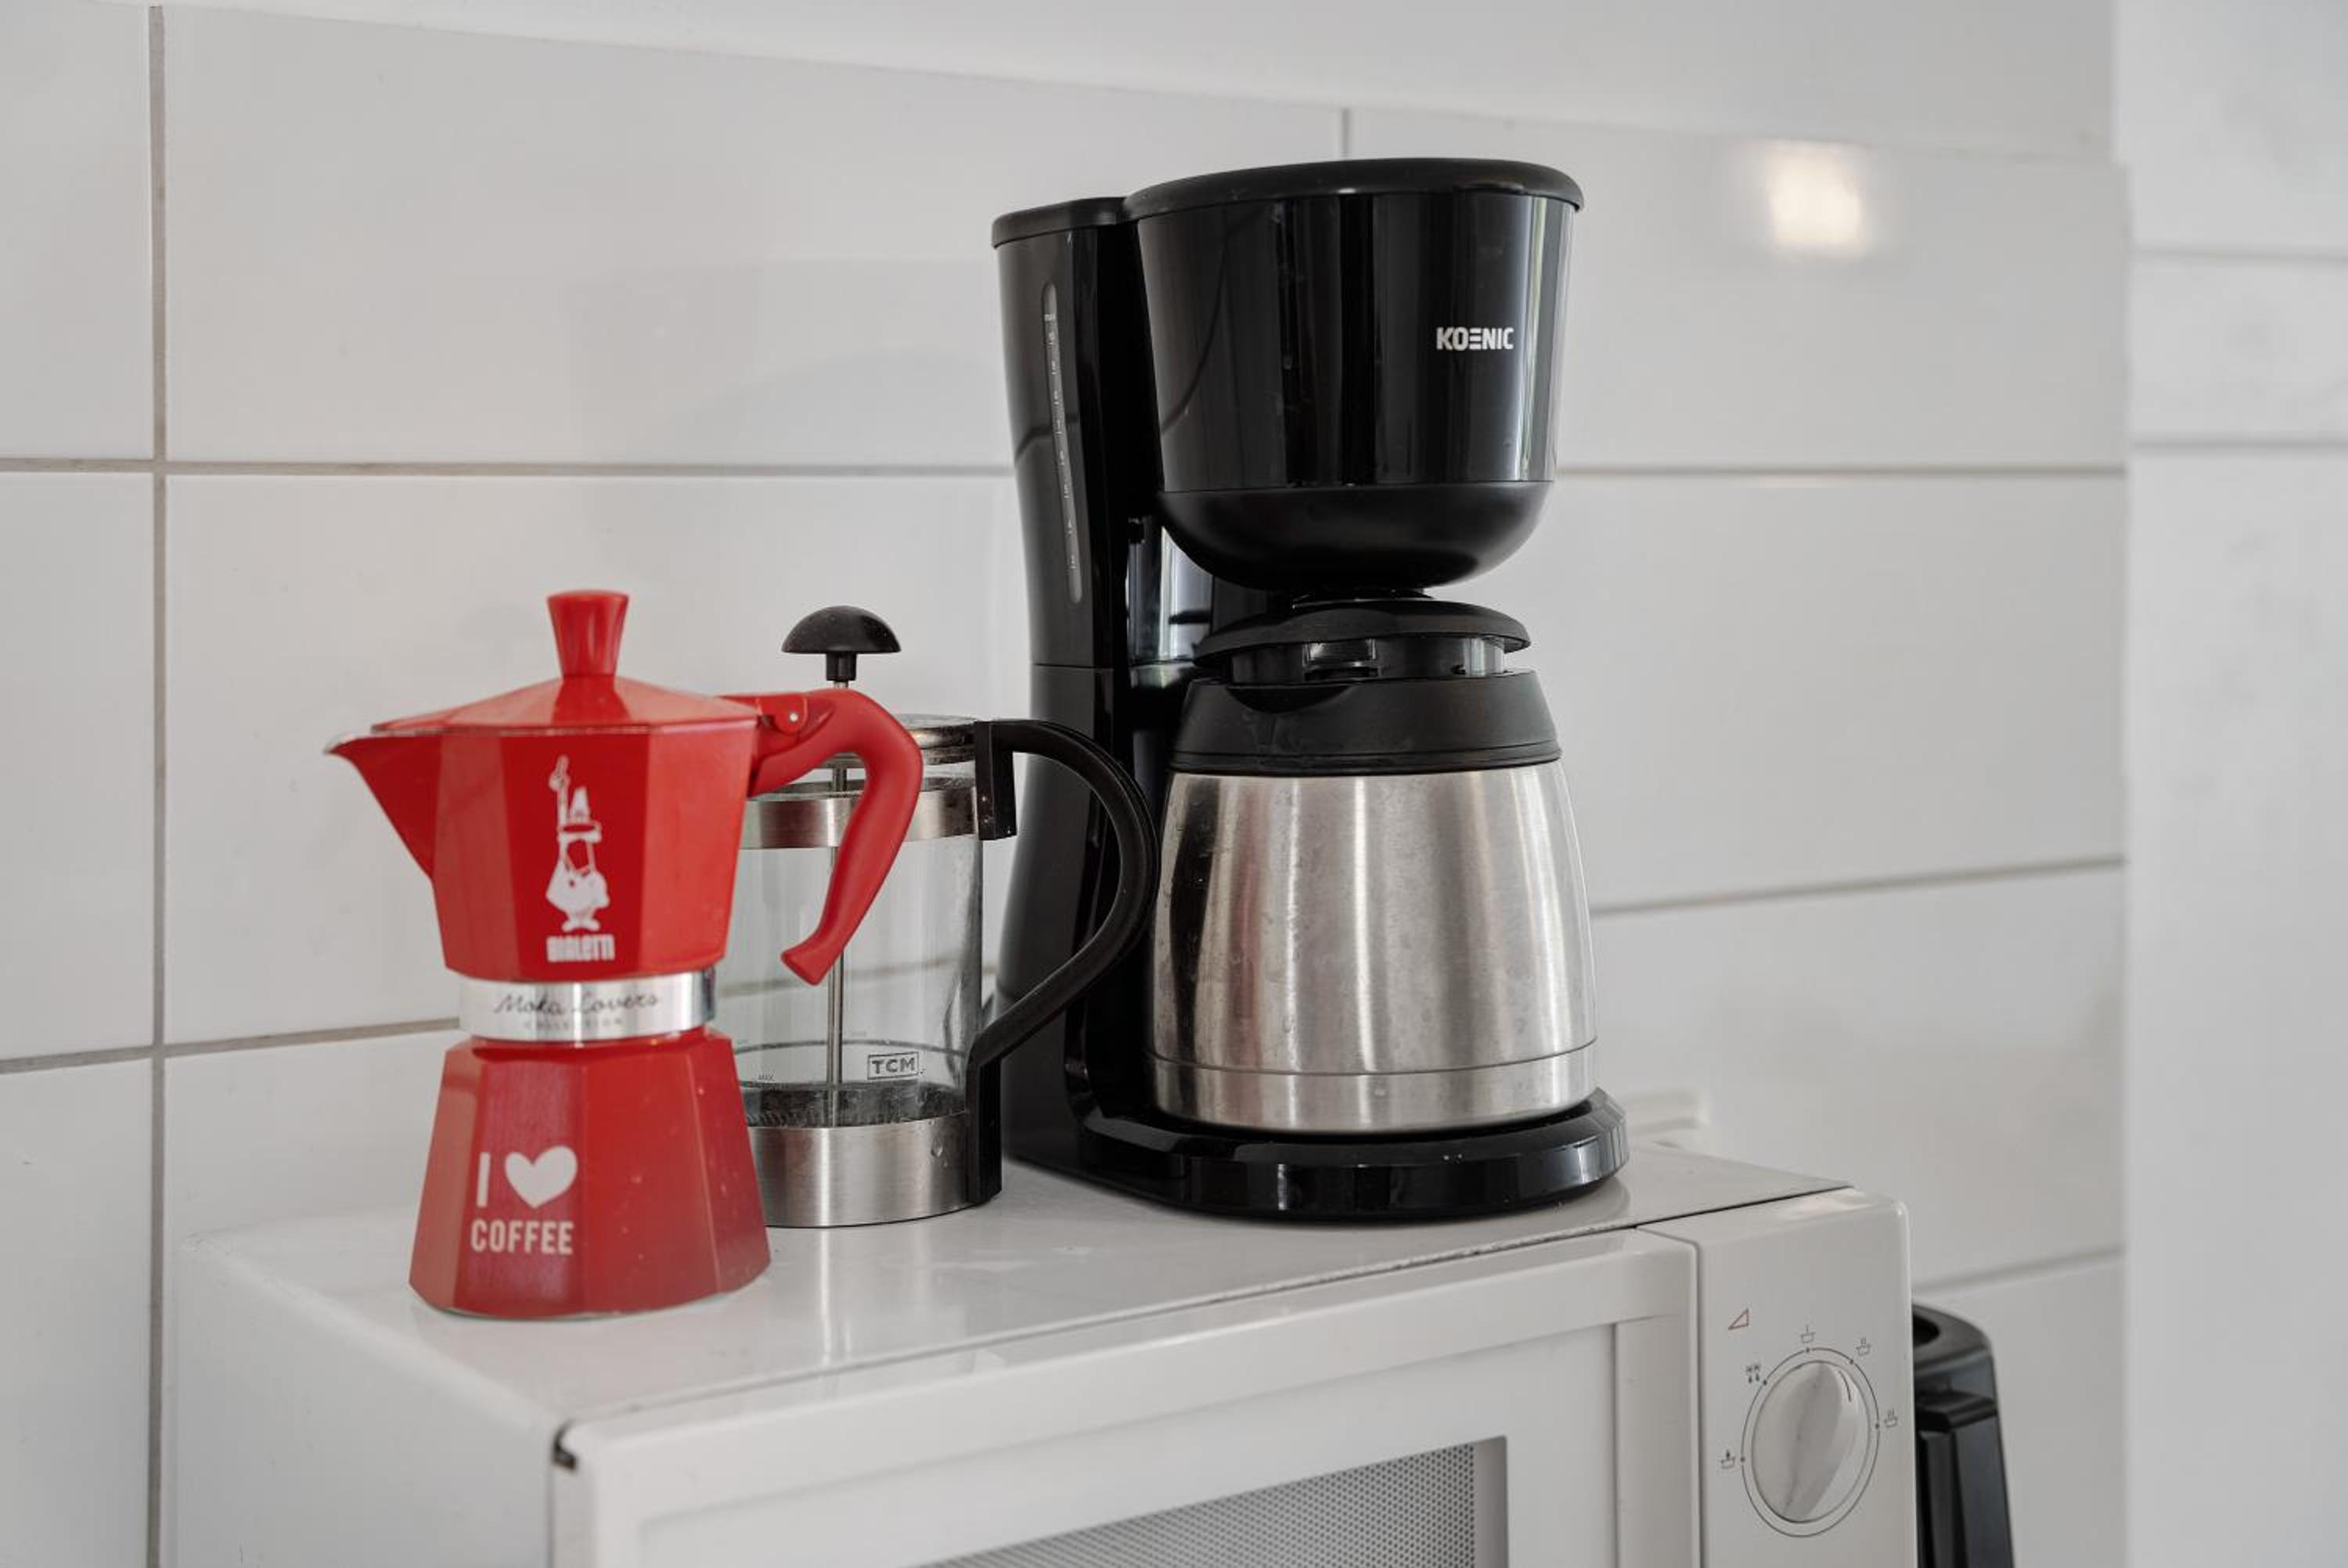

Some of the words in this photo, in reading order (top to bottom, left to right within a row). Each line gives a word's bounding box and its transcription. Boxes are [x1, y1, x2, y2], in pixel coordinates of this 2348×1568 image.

[1436, 326, 1514, 351] KOENIC
[493, 991, 564, 1016] Moka
[870, 1056, 917, 1075] TCM
[476, 1151, 492, 1208] I
[470, 1218, 574, 1256] COFFEE
